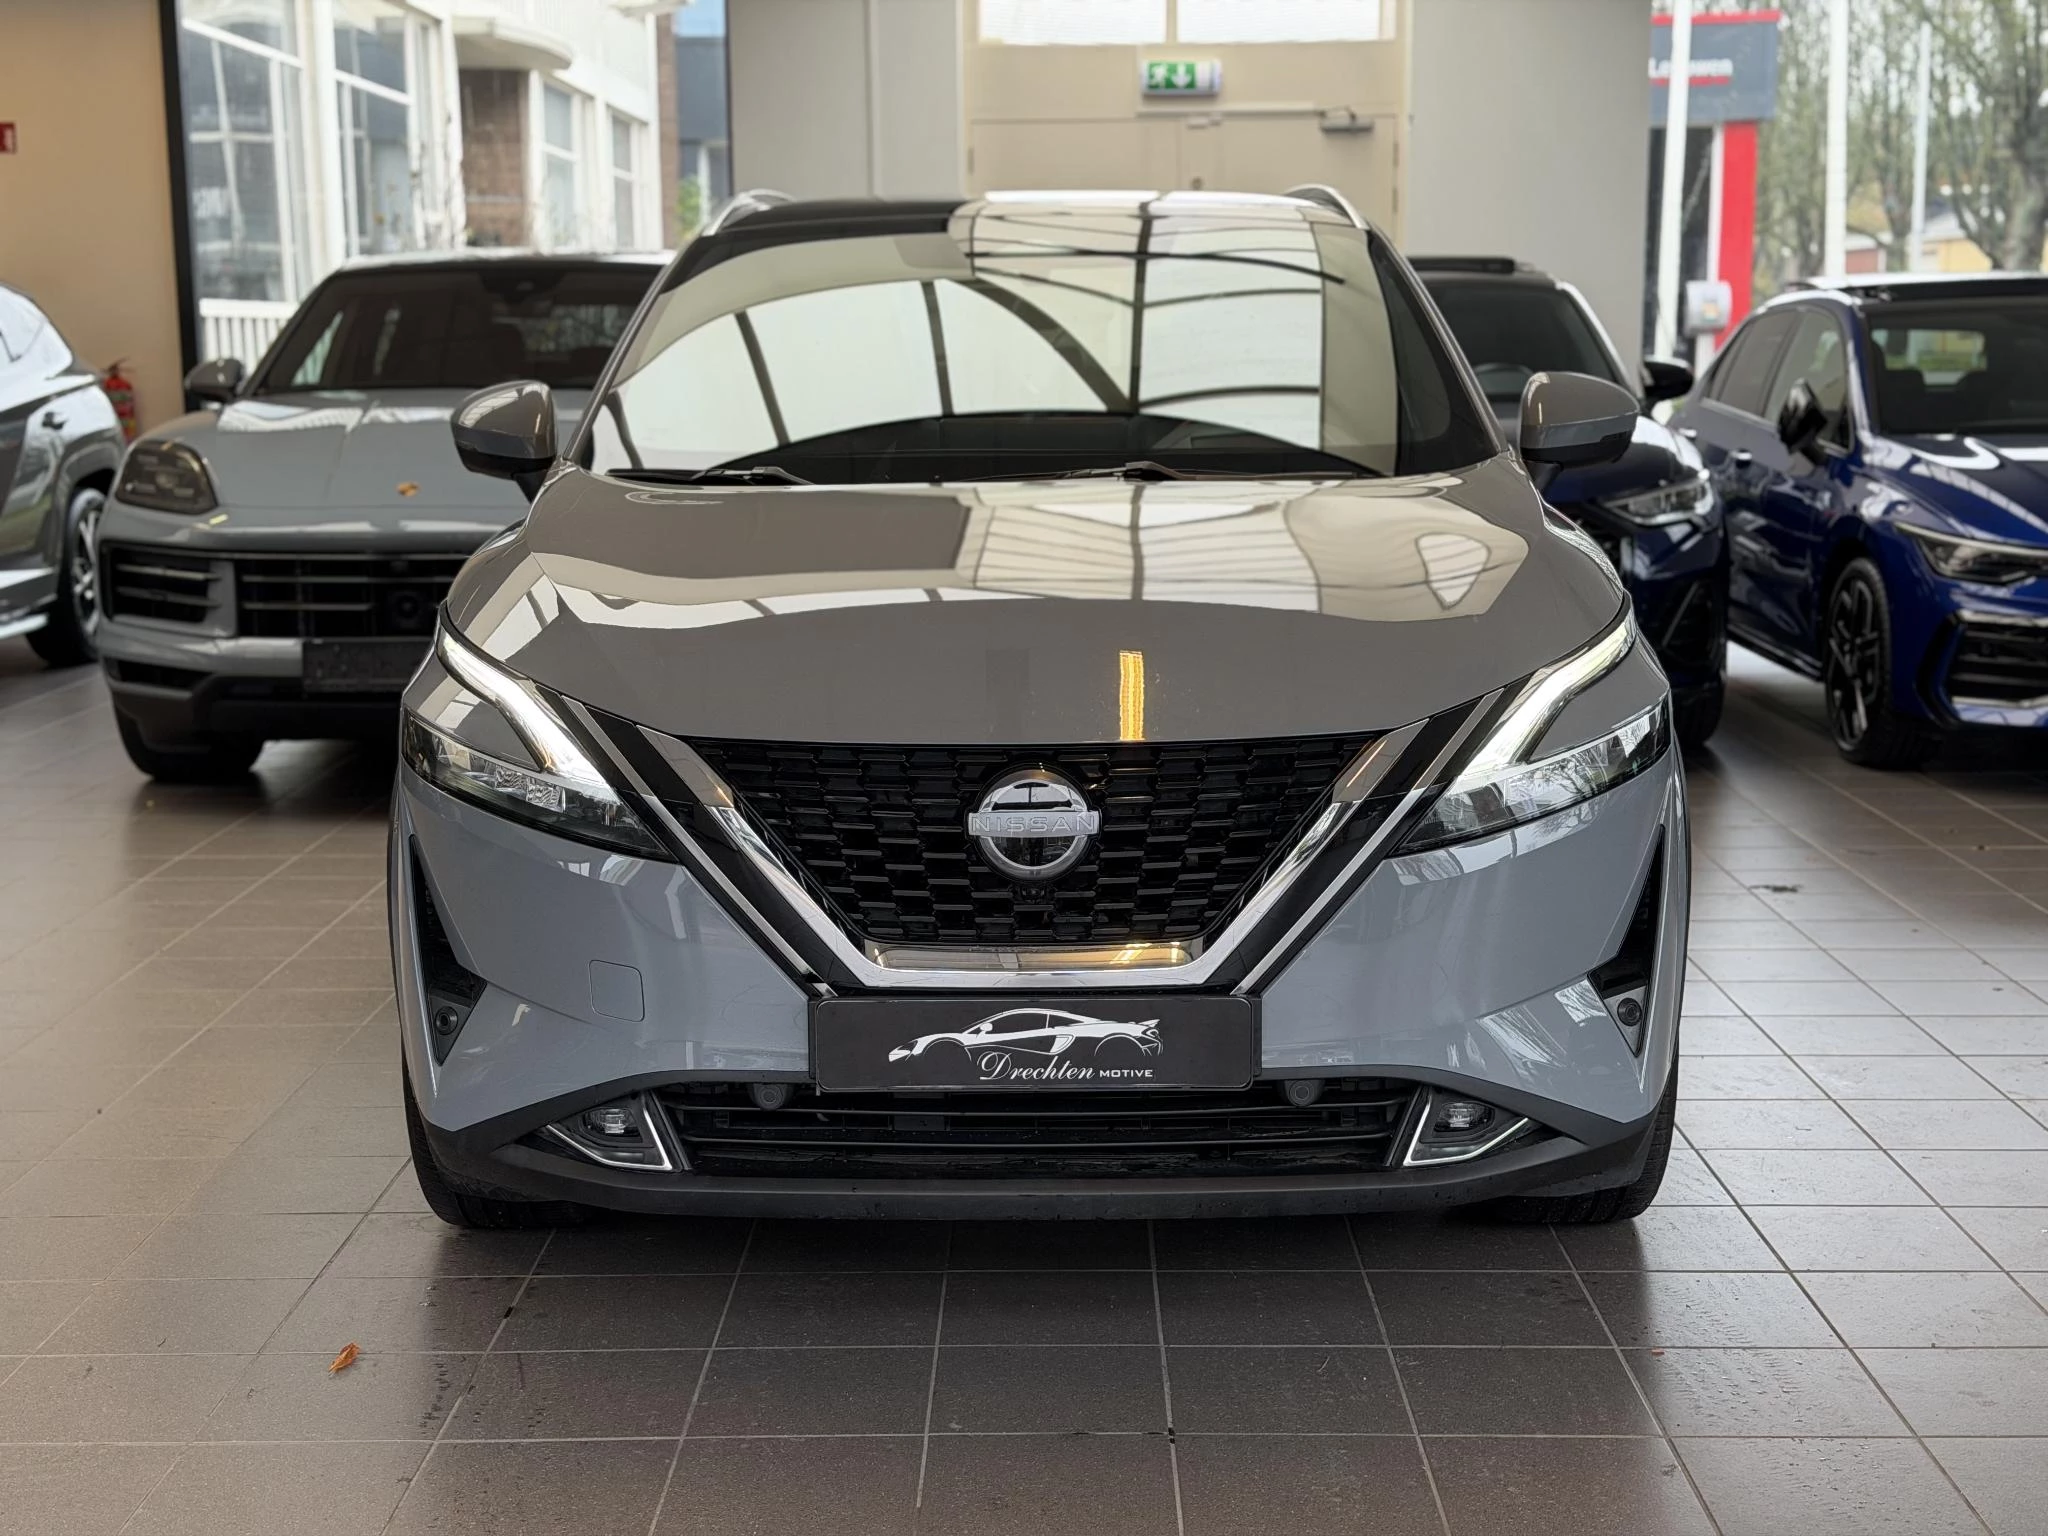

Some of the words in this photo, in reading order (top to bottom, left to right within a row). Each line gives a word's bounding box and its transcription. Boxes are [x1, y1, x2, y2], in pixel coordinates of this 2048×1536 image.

[971, 815, 1095, 833] NISSAN
[976, 1051, 1096, 1081] Drechten
[1099, 1068, 1153, 1078] MOTIVE
